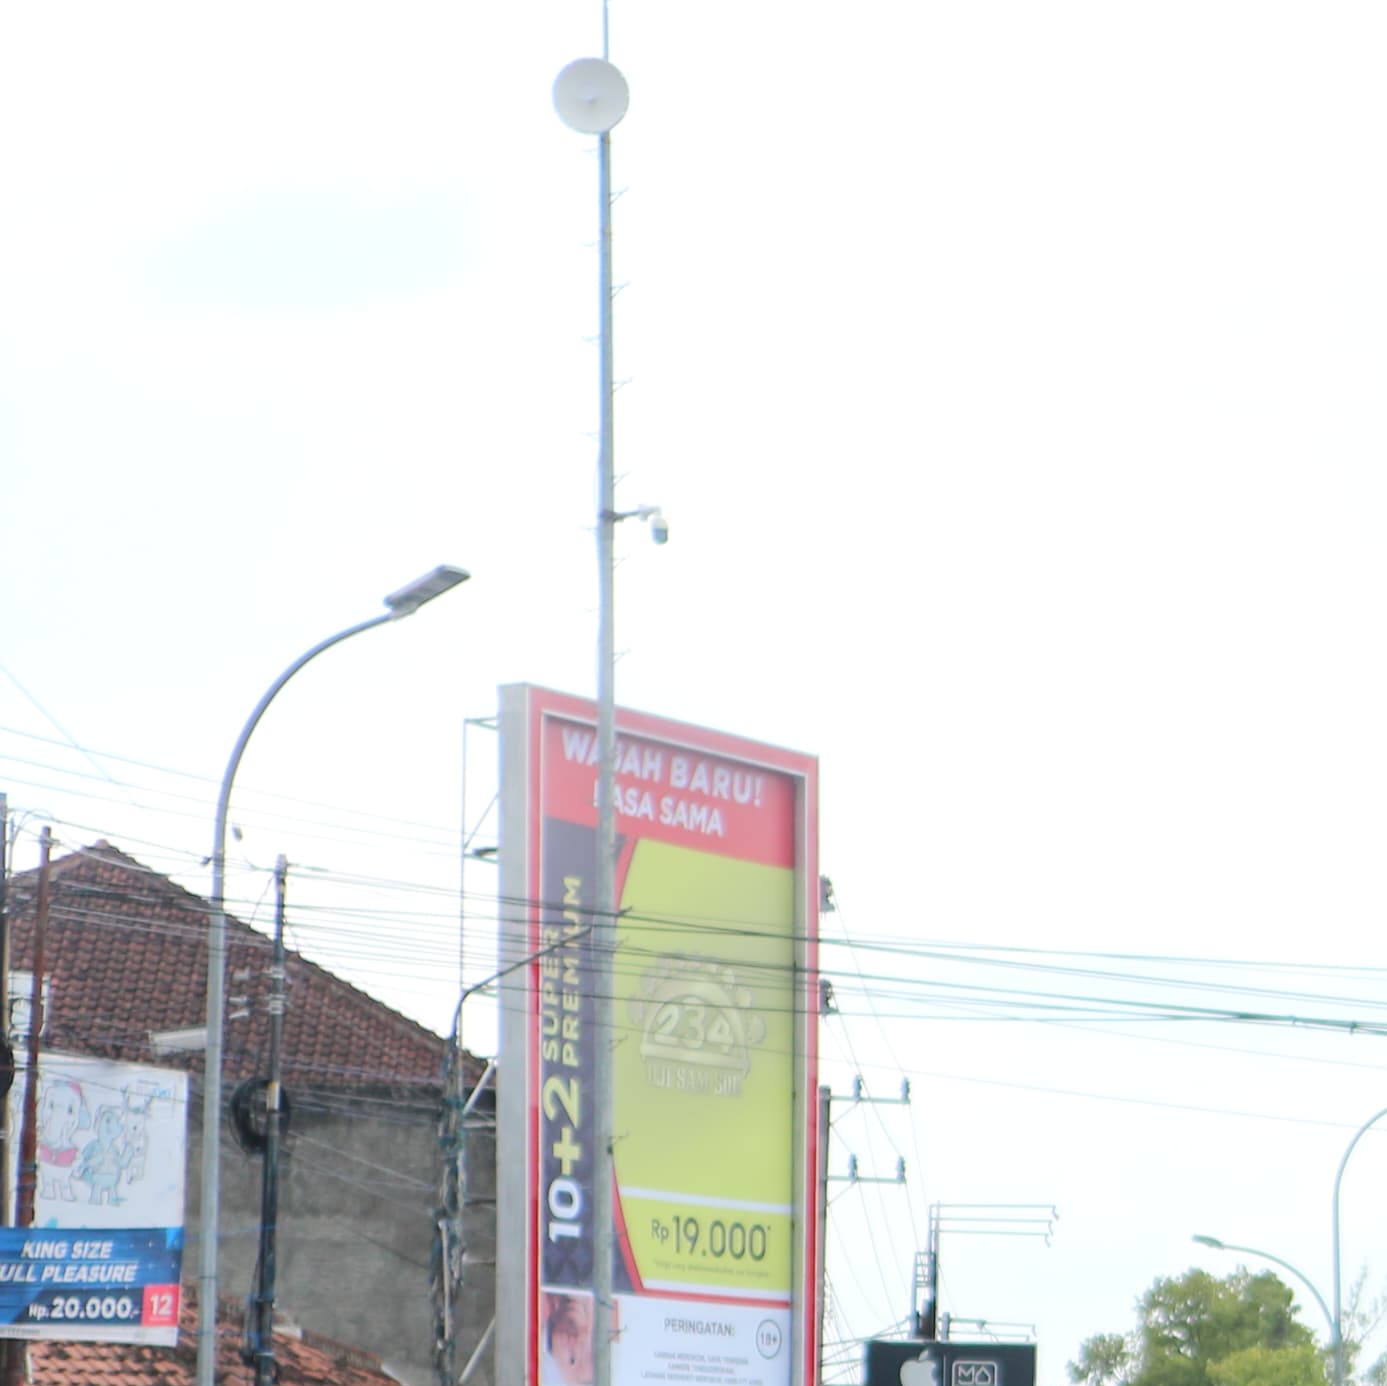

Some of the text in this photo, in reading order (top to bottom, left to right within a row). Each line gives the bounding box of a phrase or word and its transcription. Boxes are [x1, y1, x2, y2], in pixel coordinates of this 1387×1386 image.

[669, 755, 765, 807] BARU!
[660, 796, 724, 838] SAMA
[562, 876, 583, 1068] PREMIUM
[651, 1219, 669, 1245] Rp
[21, 1241, 114, 1259] KING SIZE
[41, 1264, 139, 1283] PLEASURE
[150, 1295, 173, 1315] 12
